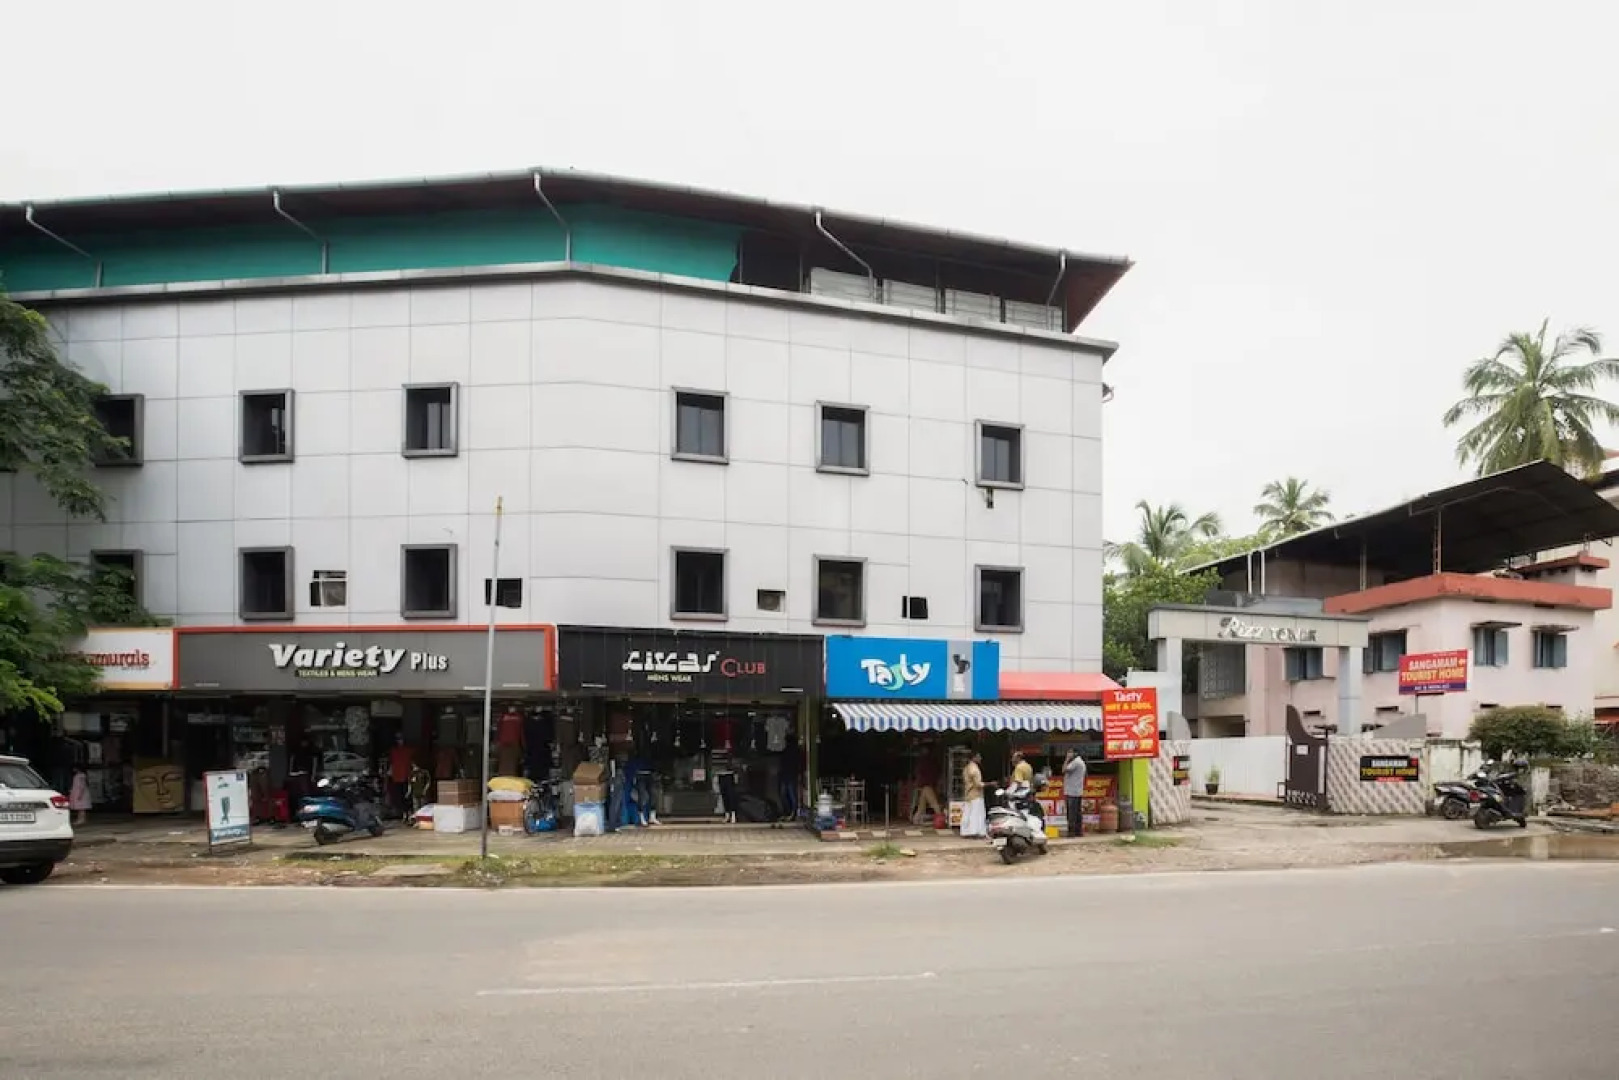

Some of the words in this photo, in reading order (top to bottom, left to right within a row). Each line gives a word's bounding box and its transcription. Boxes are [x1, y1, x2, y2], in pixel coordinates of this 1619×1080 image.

[268, 641, 406, 673] Variety
[410, 652, 449, 670] Plus
[1401, 669, 1437, 682] TOURIST
[1438, 667, 1465, 678] HOME
